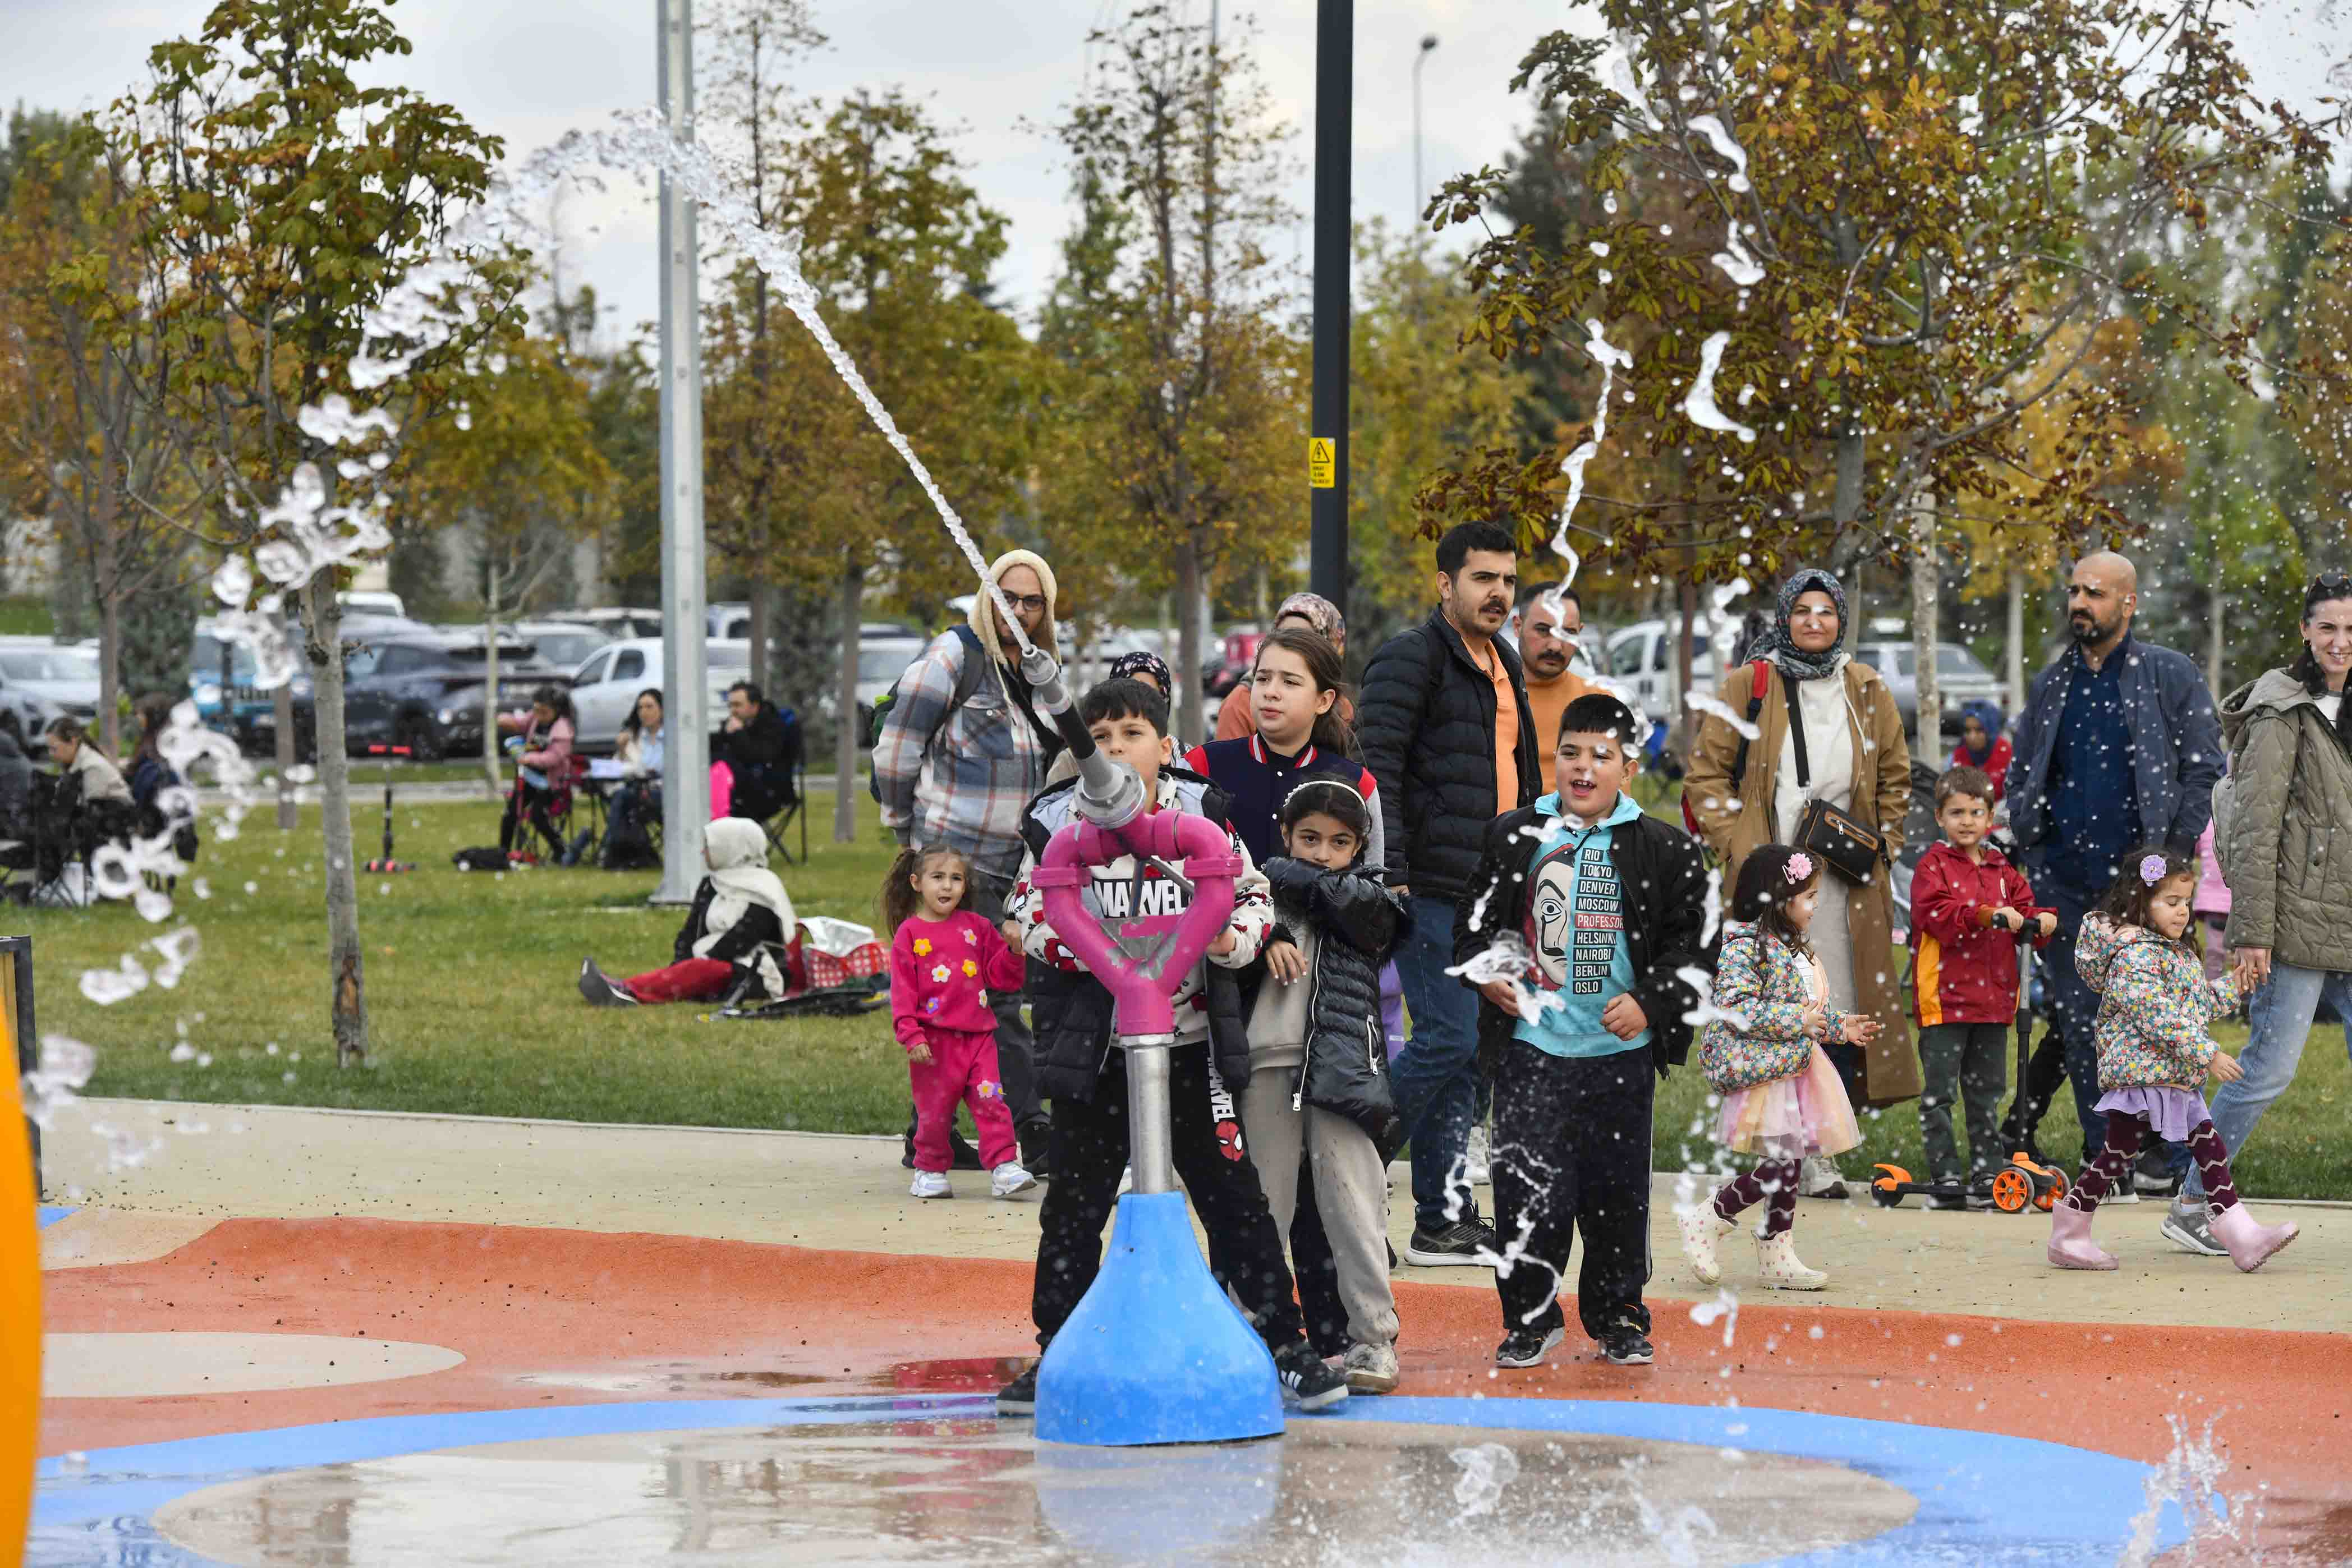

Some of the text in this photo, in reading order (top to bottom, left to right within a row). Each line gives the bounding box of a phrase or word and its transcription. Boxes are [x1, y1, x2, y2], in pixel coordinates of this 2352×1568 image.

[1584, 849, 1600, 861] RIO
[1582, 864, 1612, 878] TOKYO
[1579, 880, 1616, 895] DENVER
[1578, 897, 1619, 912] MOSCOW
[1577, 914, 1624, 929] PROFESSOR
[1577, 932, 1616, 944] HELSINKI
[1575, 948, 1611, 961] NAIROBI
[1575, 965, 1607, 977] BERLIN
[1575, 981, 1599, 994] OSLO
